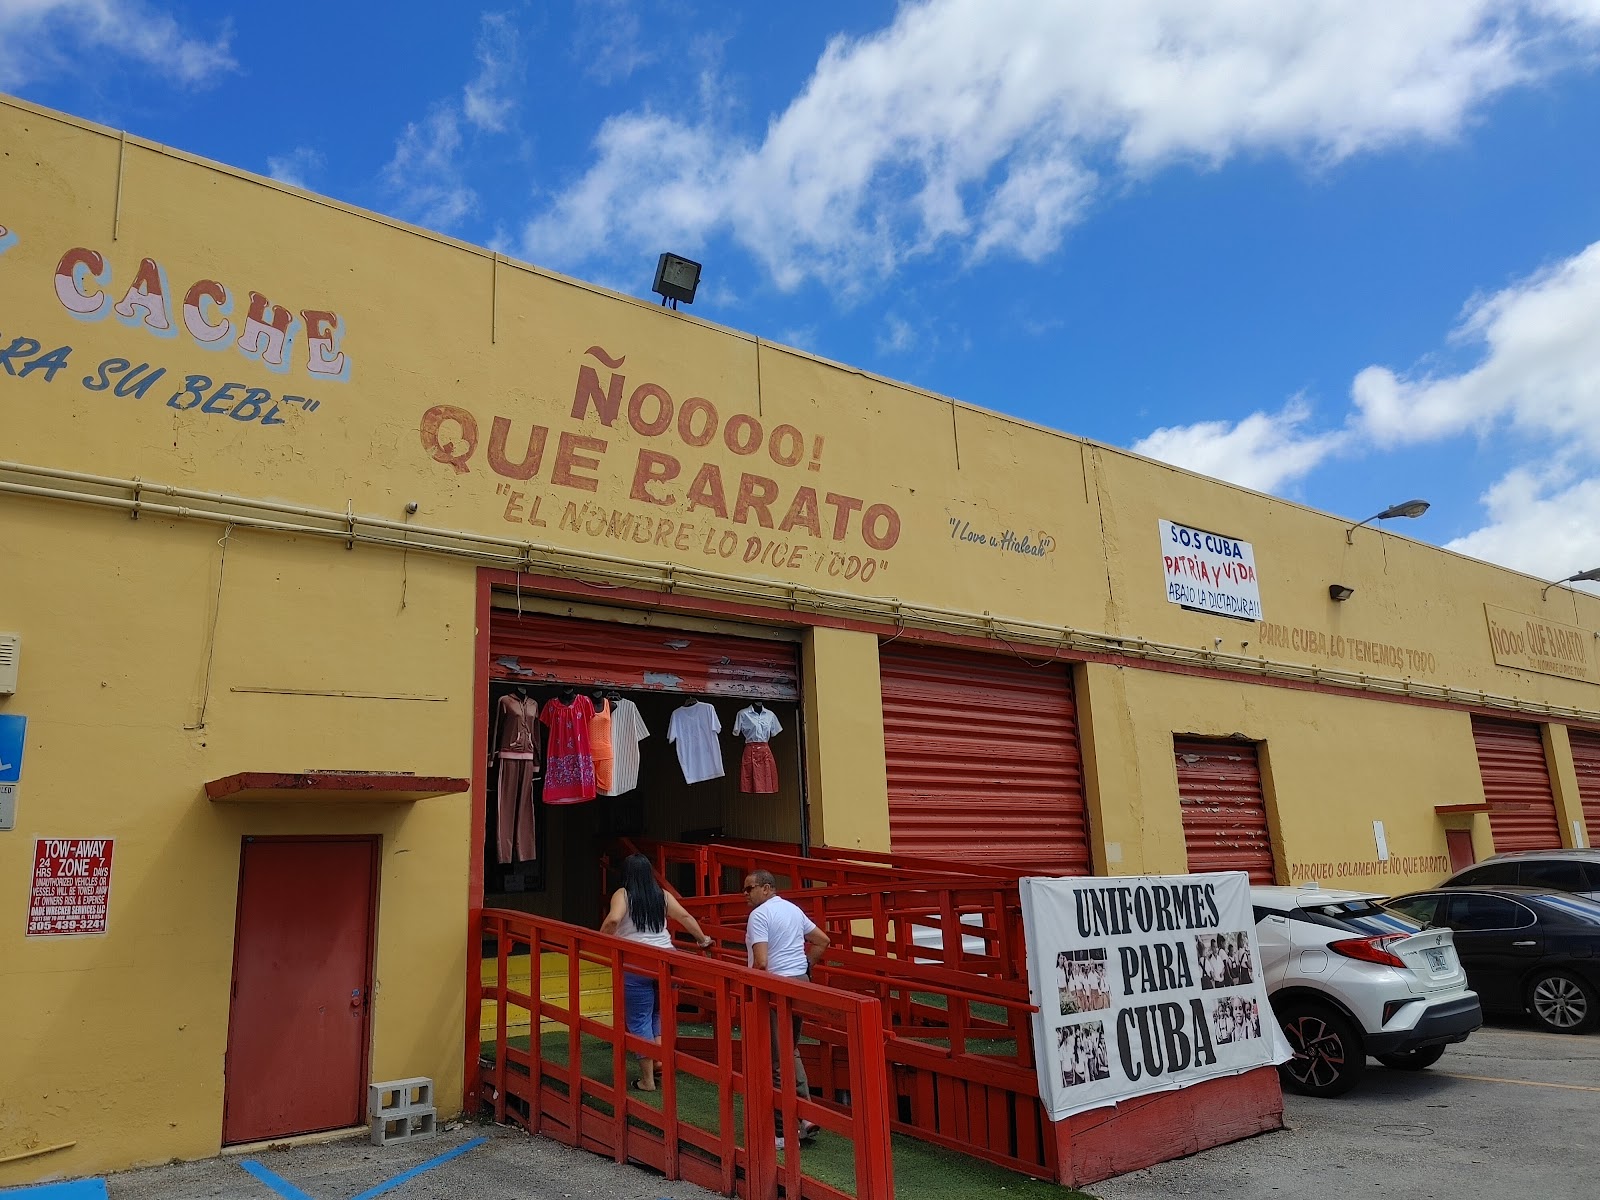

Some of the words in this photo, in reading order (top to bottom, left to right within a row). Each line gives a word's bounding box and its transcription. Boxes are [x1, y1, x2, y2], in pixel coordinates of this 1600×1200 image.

[54, 247, 347, 377] CACHE
[82, 358, 167, 399] SU
[570, 345, 825, 472] ÑOOOO!
[420, 404, 609, 493] QUE
[629, 448, 900, 551] BARATO
[559, 501, 696, 551] NOMBRE
[703, 527, 738, 557] LO
[743, 536, 808, 569] DICE
[960, 522, 986, 545] Love
[1205, 536, 1243, 559] CUBA
[1169, 582, 1196, 603] ABAJO
[1198, 588, 1207, 607] LA
[1259, 621, 1290, 649] PARA
[1347, 638, 1403, 669] TENEMOS
[1406, 649, 1436, 675] TODO
[1526, 621, 1549, 656] QUE
[45, 840, 106, 858] TOW-AWAY
[36, 868, 52, 877] HRS
[39, 858, 50, 868] 24
[57, 859, 90, 876] ZONE
[93, 867, 108, 876] DAYS
[99, 858, 105, 867] 7
[1292, 863, 1334, 881] PARQUEO
[1336, 860, 1388, 878] SOLAMENTE
[1389, 852, 1400, 875] ÑO
[1403, 857, 1418, 877] QUE
[1418, 855, 1448, 874] BARATO
[32, 887, 55, 896] VESSELS
[57, 887, 67, 895] WILL
[69, 887, 76, 895] BE
[78, 887, 94, 895] TOWED
[36, 878, 73, 887] UNAUTHORIZED
[75, 877, 98, 886] VEHICLES
[99, 877, 107, 886] OR
[34, 896, 41, 906] AT
[64, 896, 76, 905] RISK
[83, 896, 105, 905] EXPENSE
[46, 905, 71, 916] WRECKER
[72, 905, 96, 915] SERVICES
[1073, 883, 1220, 938] UNIFORMES
[29, 920, 104, 931] 305-439-3241
[1118, 941, 1194, 996] PARA
[1116, 998, 1217, 1082] CUBA
